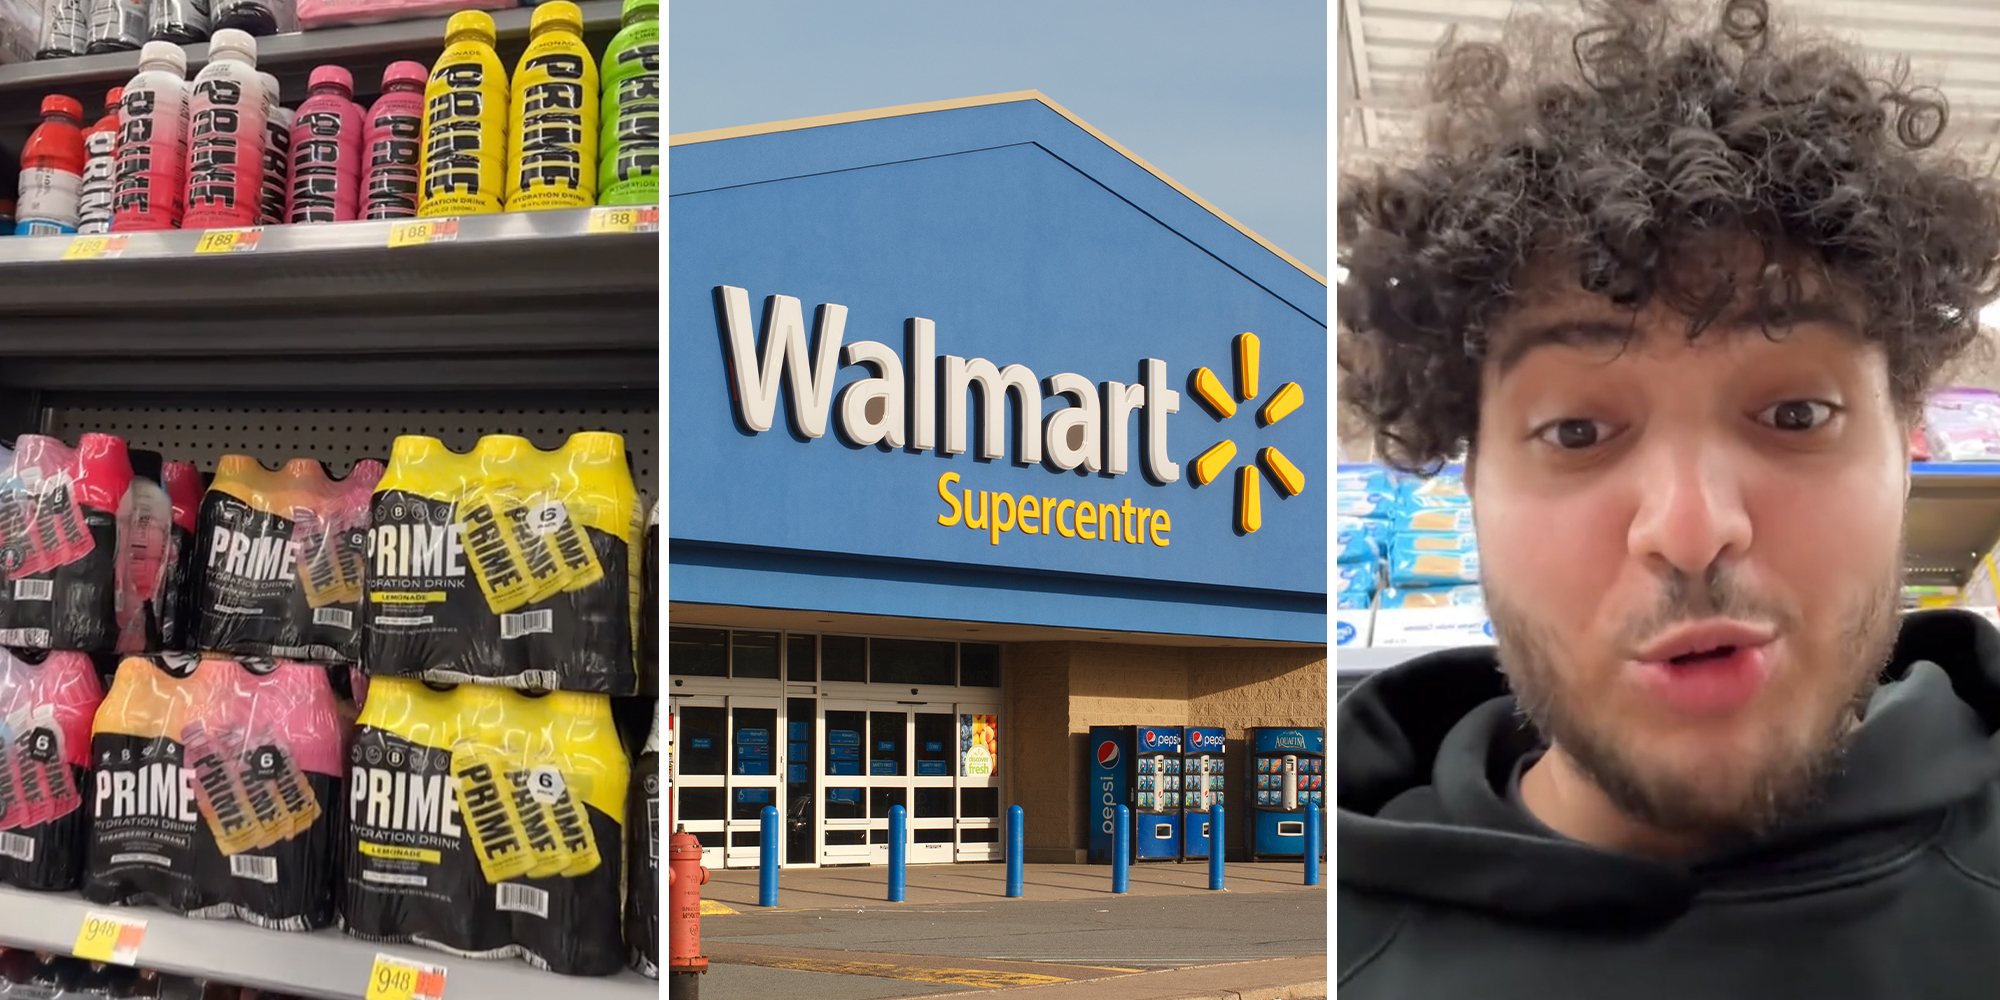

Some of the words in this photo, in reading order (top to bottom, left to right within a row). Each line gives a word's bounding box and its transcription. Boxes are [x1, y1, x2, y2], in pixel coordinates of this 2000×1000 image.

[520, 54, 584, 193] PRIME
[425, 63, 484, 200] PRIME
[189, 80, 241, 209] PRIME
[261, 121, 291, 225] PRIM
[460, 197, 486, 206] DRINK
[713, 284, 1180, 484] Walmart
[540, 507, 557, 521] 6
[937, 470, 1171, 547] Supercentre
[352, 533, 363, 545] 6
[208, 525, 304, 581] PRIME
[462, 503, 522, 593] PRIME
[425, 578, 466, 589] DRINK
[381, 593, 427, 601] LEMONADE
[36, 735, 49, 750] 6
[1158, 733, 1178, 747] pepsi
[1204, 734, 1225, 747] pepsi
[1275, 734, 1306, 749] AQUAFINA
[260, 753, 274, 768] 6
[968, 763, 989, 774] fresh
[538, 773, 554, 788] 6
[95, 762, 198, 822] PRIME
[350, 766, 463, 838] PRIME
[457, 763, 521, 860] PRIME
[94, 817, 159, 831] HYDRATION
[161, 819, 197, 832] DRINK
[100, 830, 151, 842] STRAWBERRY
[153, 832, 186, 846] BANANA
[419, 834, 461, 850] DRINK
[371, 847, 422, 858] LEMONADE
